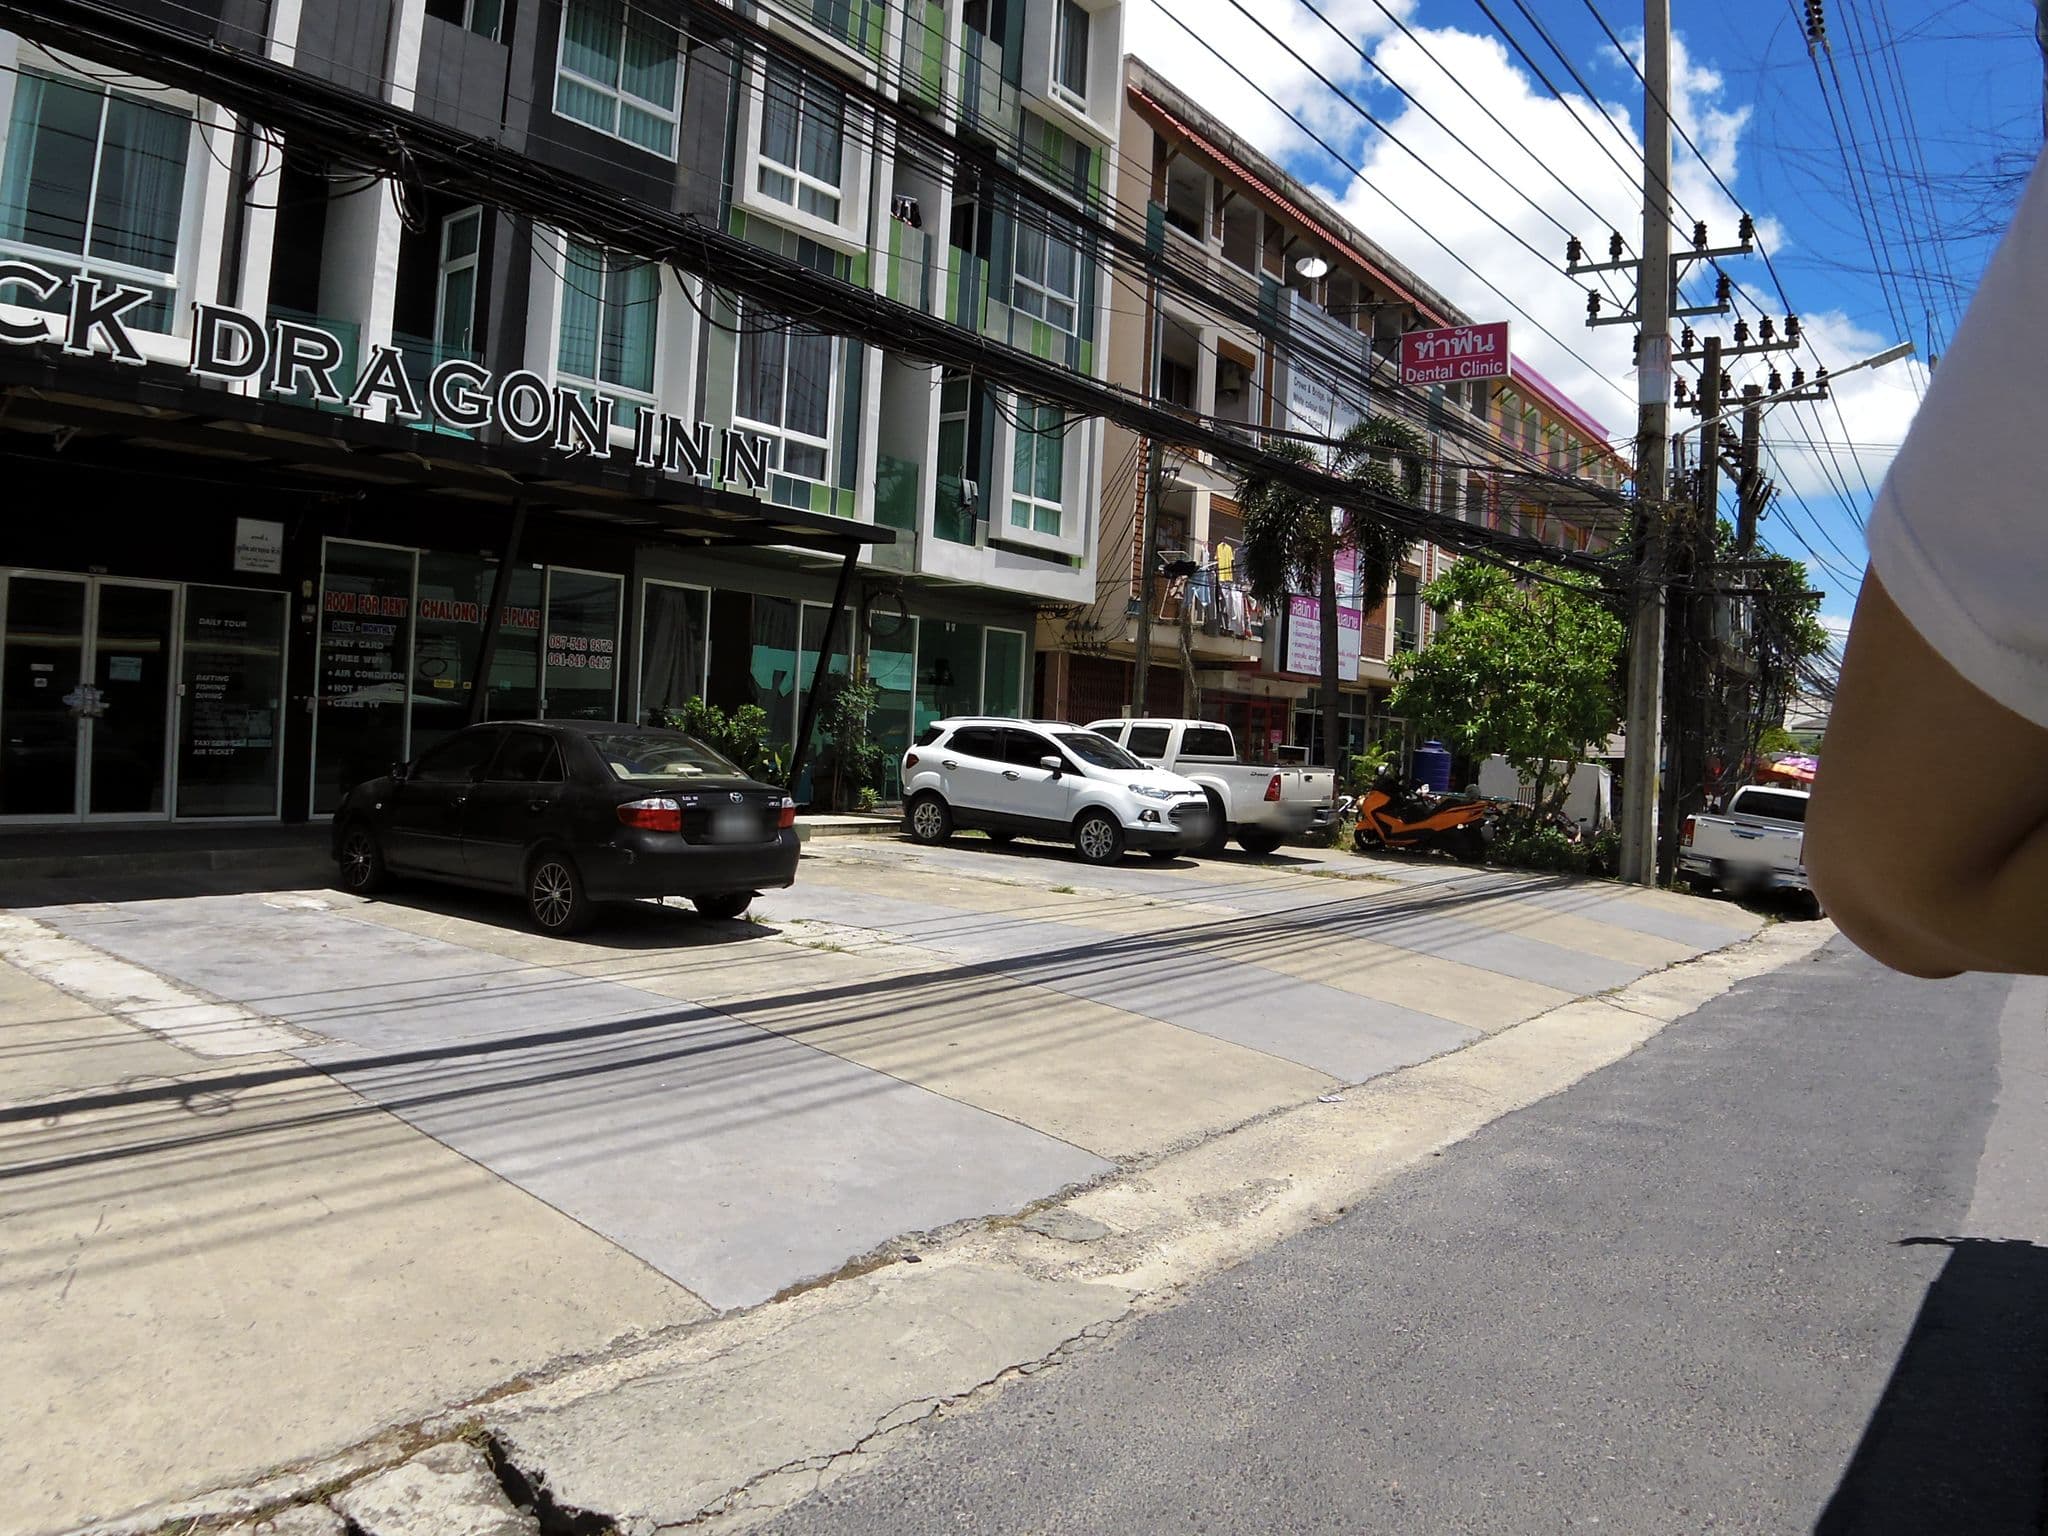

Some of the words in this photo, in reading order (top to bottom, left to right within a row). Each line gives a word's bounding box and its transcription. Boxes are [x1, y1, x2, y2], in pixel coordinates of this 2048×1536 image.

[1414, 328, 1495, 360] ทำฟัน
[1405, 363, 1453, 383] Dental
[1460, 358, 1503, 377] Clinic
[189, 301, 613, 458] DRAGON
[634, 406, 771, 489] INN
[325, 591, 356, 613] ROOM
[358, 594, 380, 616] FOR
[381, 597, 409, 618] RENT
[420, 599, 479, 624] CHALONG
[509, 607, 541, 630] PLACE
[223, 620, 247, 629] TOUR
[358, 641, 385, 649] CARD
[334, 670, 351, 678] AIR
[354, 671, 405, 681] CONDITION
[333, 684, 354, 693] HOT
